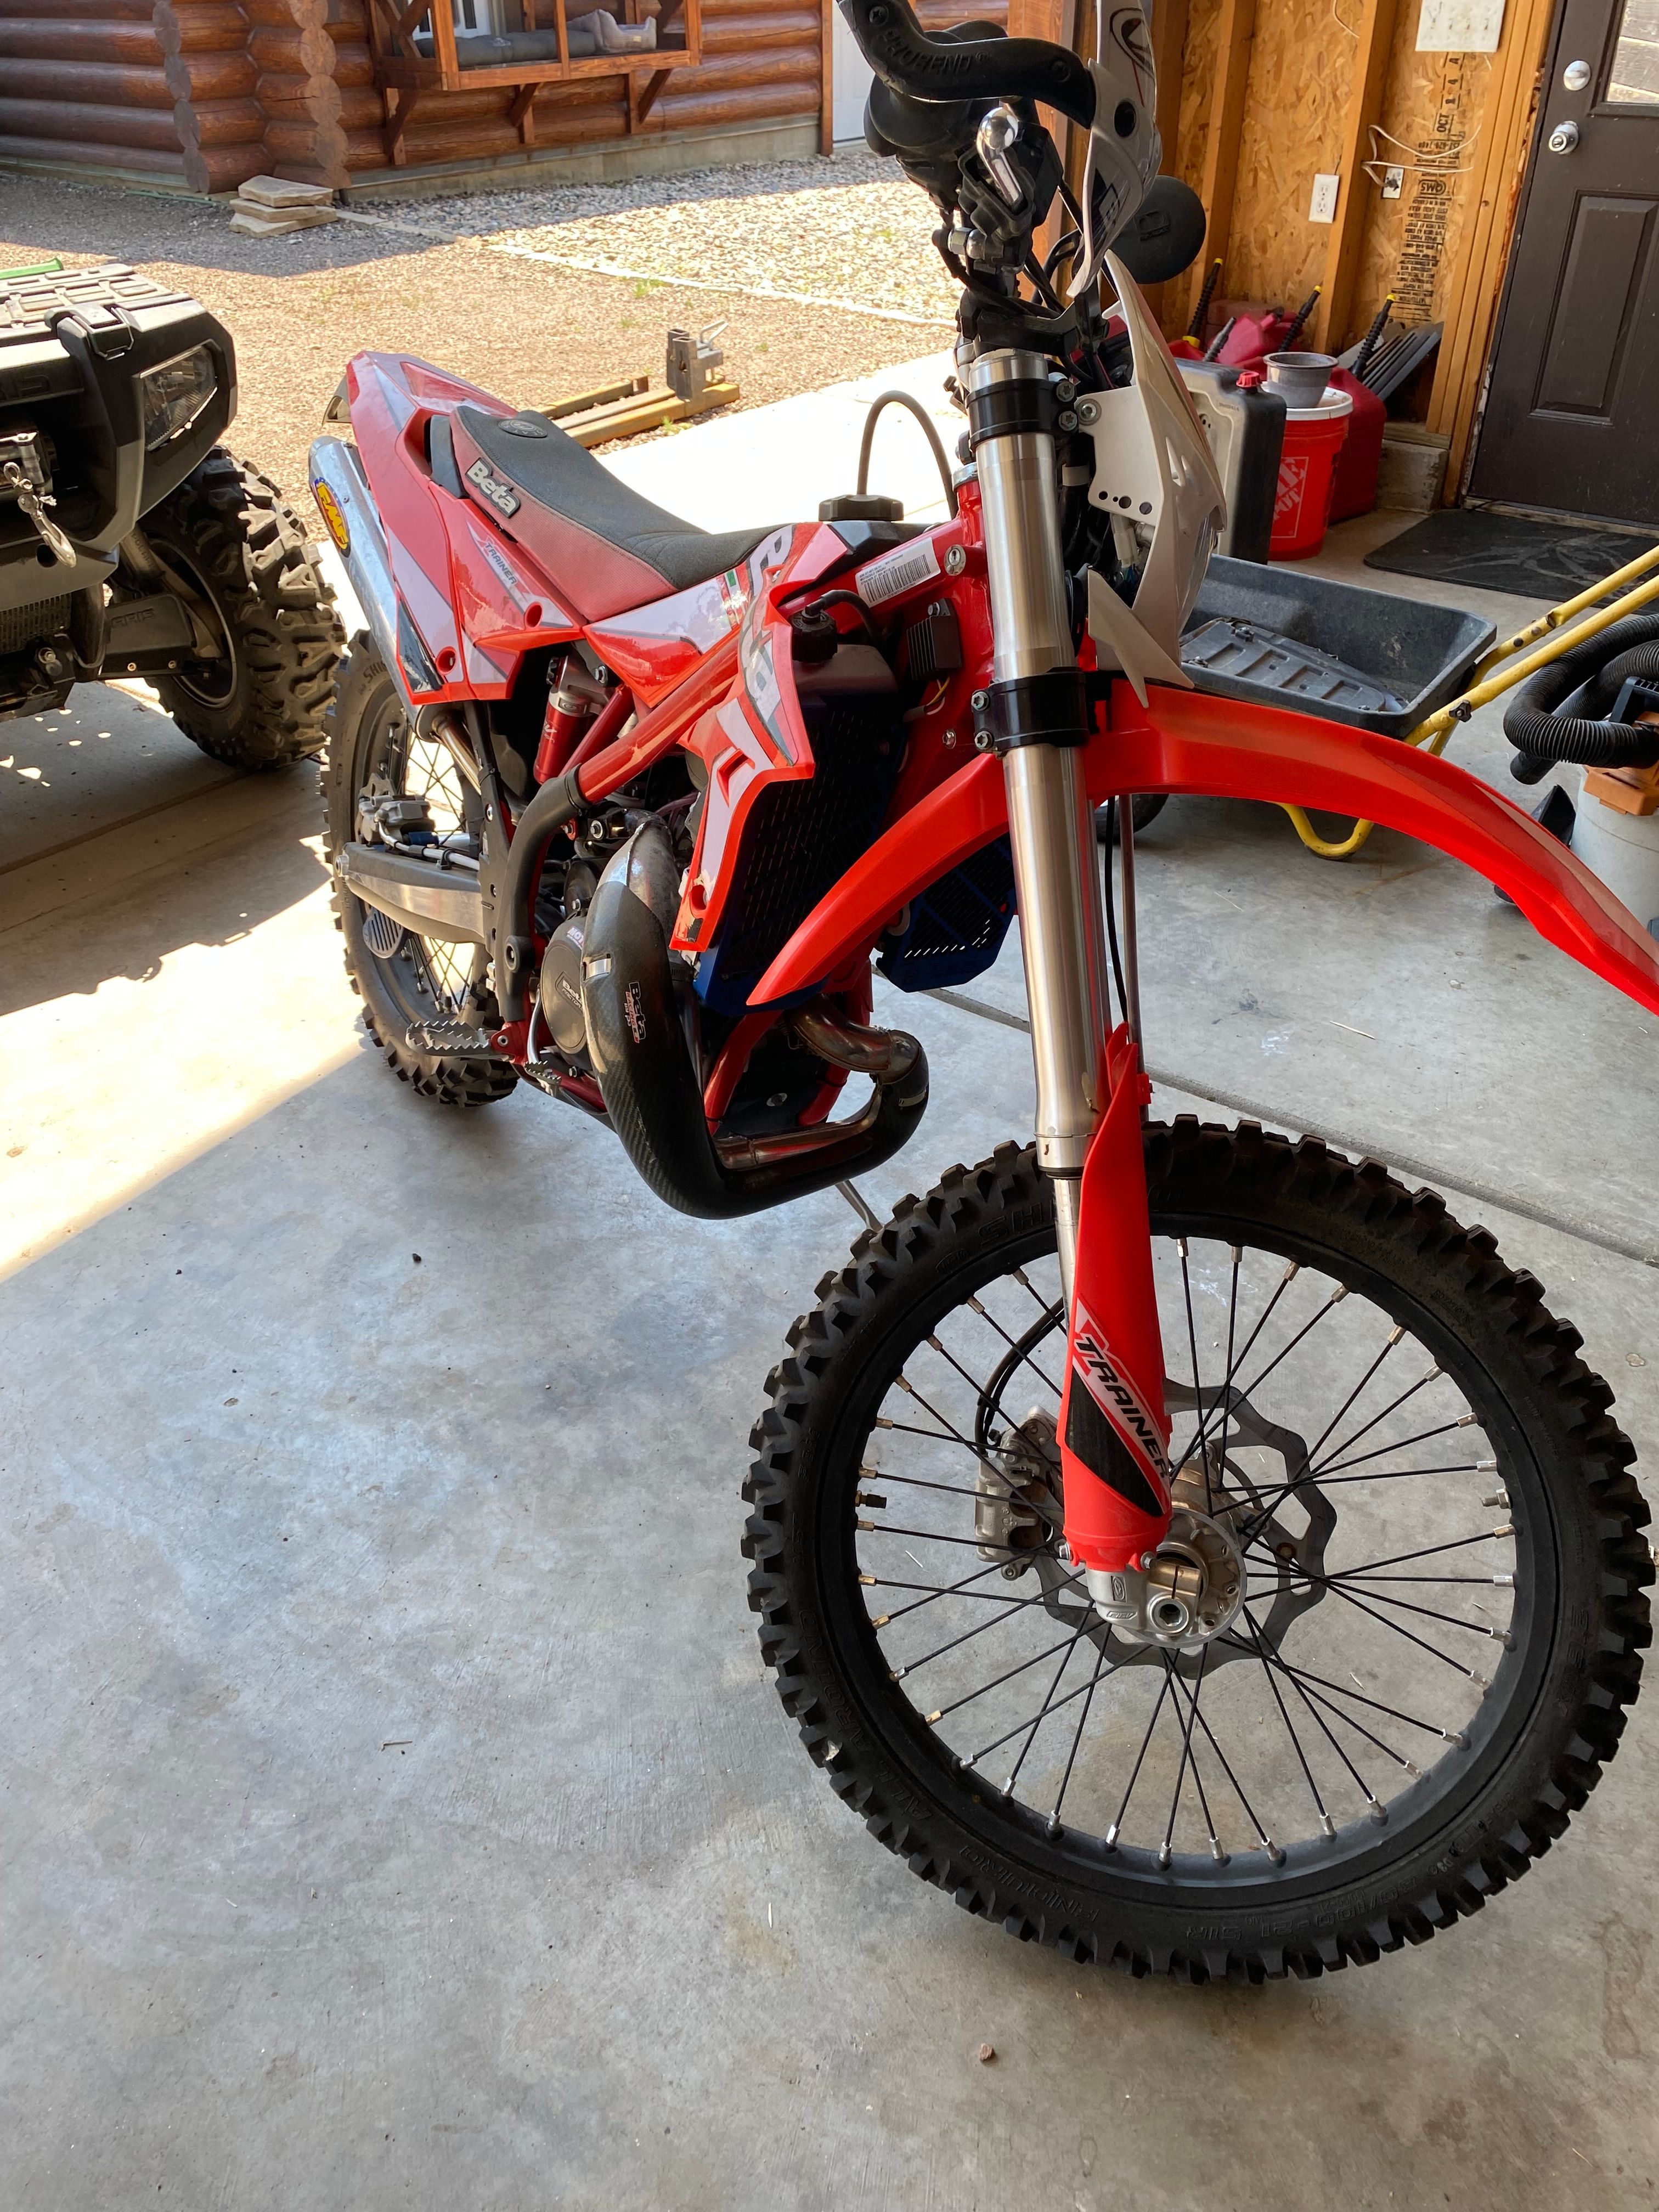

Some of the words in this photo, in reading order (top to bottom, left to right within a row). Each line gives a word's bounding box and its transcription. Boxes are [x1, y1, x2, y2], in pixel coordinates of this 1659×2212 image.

[1420, 181, 1443, 193] QMS
[466, 459, 517, 515] Beta
[317, 484, 349, 545] FMF
[111, 607, 156, 628] ARIS
[567, 927, 584, 945] MOT
[628, 980, 647, 1041] Beta
[978, 1198, 1057, 1247] SHI
